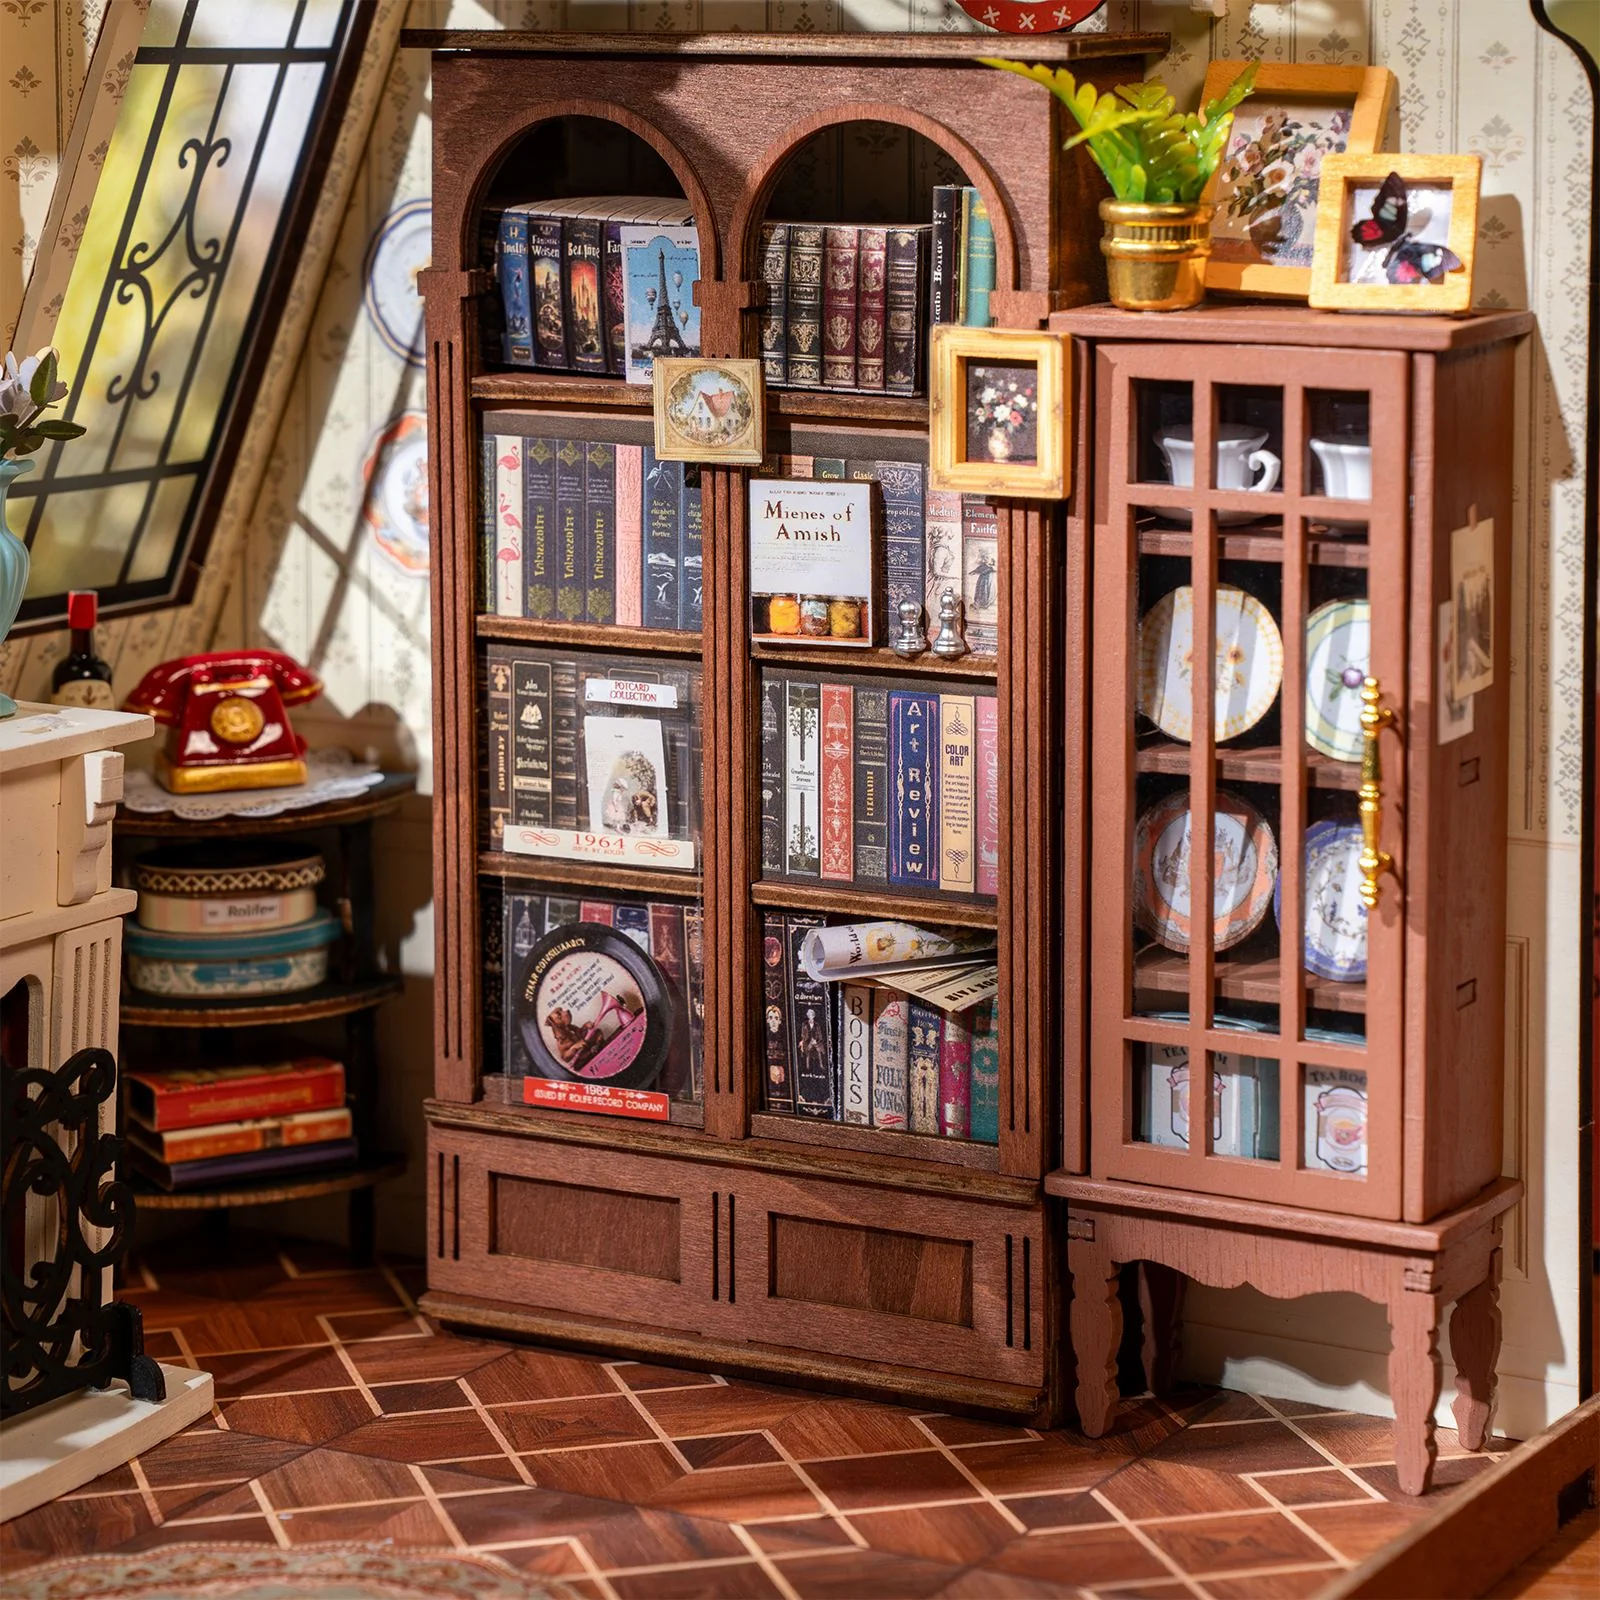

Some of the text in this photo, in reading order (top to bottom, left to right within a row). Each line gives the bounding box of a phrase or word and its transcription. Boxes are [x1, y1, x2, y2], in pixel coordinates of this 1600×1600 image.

[764, 499, 855, 521] Mienes of
[776, 523, 841, 541] Amish
[610, 690, 657, 702] COLLECTION
[907, 701, 922, 753] Art
[945, 744, 969, 756] COLOR
[949, 755, 965, 767] ART
[906, 767, 923, 873] Review
[575, 833, 624, 849] 1964
[849, 996, 863, 1105] BOOKS
[625, 1100, 664, 1112] COMPANY
